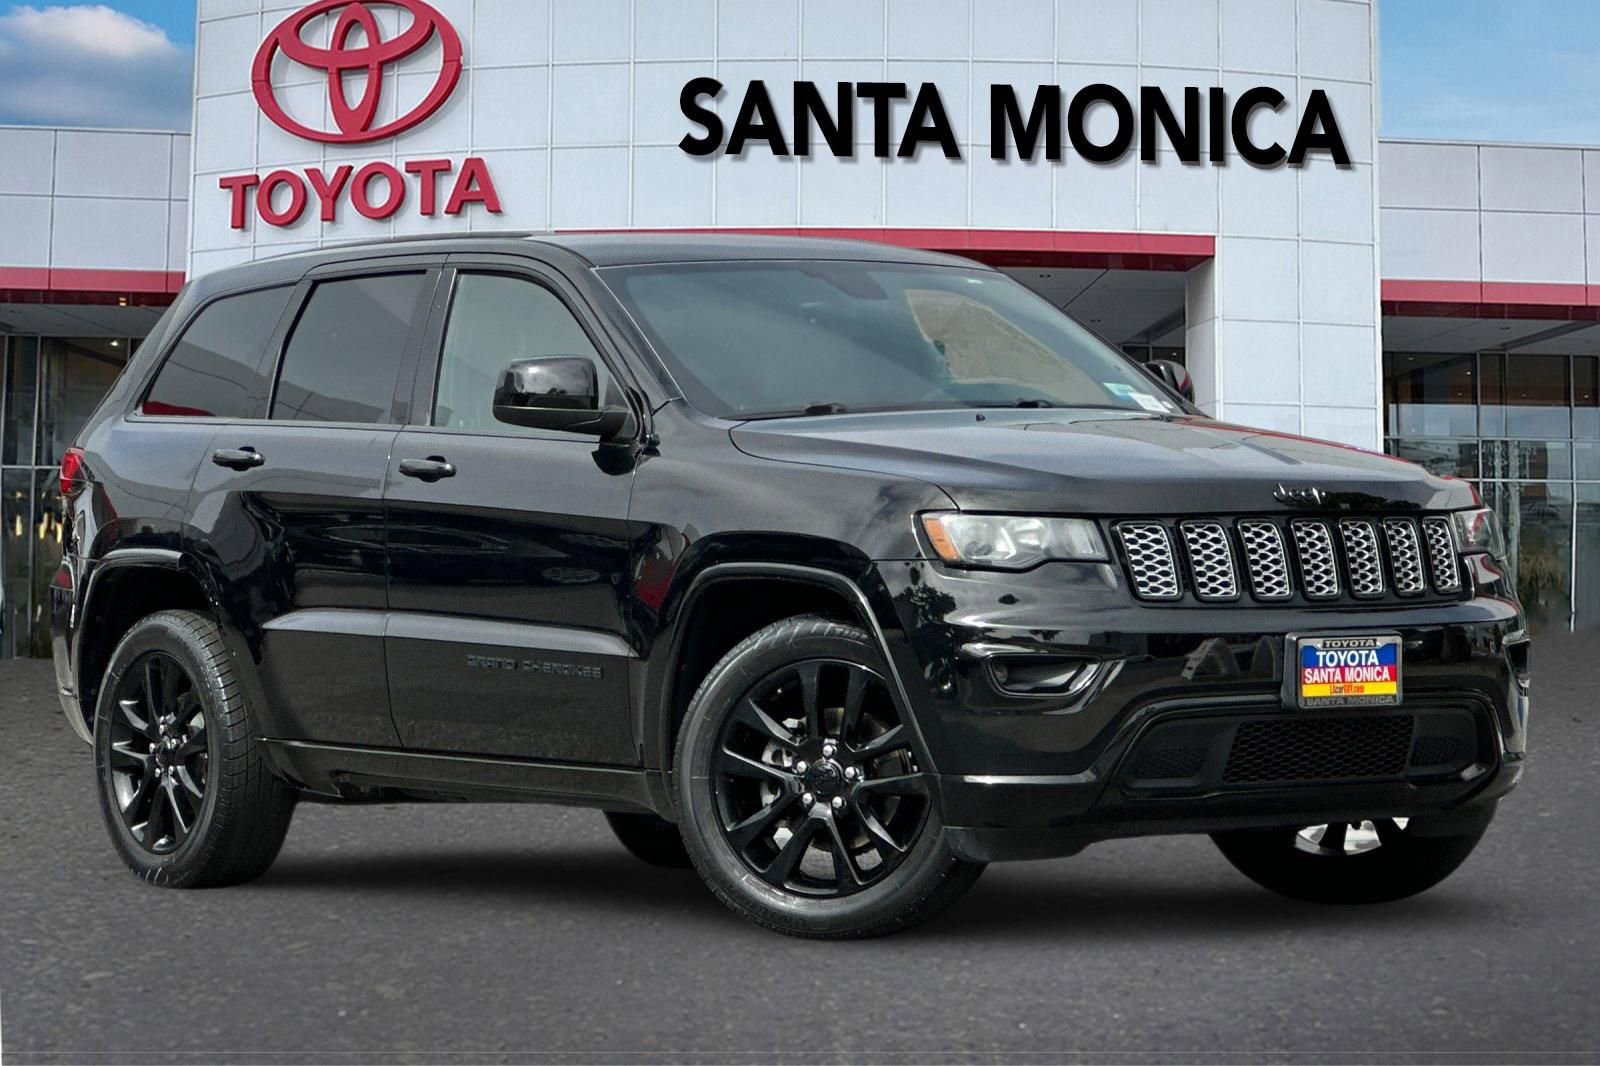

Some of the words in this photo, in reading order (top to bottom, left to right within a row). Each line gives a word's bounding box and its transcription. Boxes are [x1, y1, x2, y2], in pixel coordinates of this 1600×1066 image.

[679, 77, 961, 159] SANTA
[990, 83, 1352, 169] MONICA
[219, 157, 502, 229] TOYOTA
[1272, 483, 1327, 505] Jeep
[1325, 639, 1375, 648] TOYOTA
[465, 654, 518, 671] GRAND
[1316, 650, 1379, 667] TOYOTA
[1304, 667, 1342, 684] SANTA
[1345, 666, 1390, 682] MONICA
[1306, 696, 1345, 706] SANTA
[1347, 695, 1394, 705] MONICA
